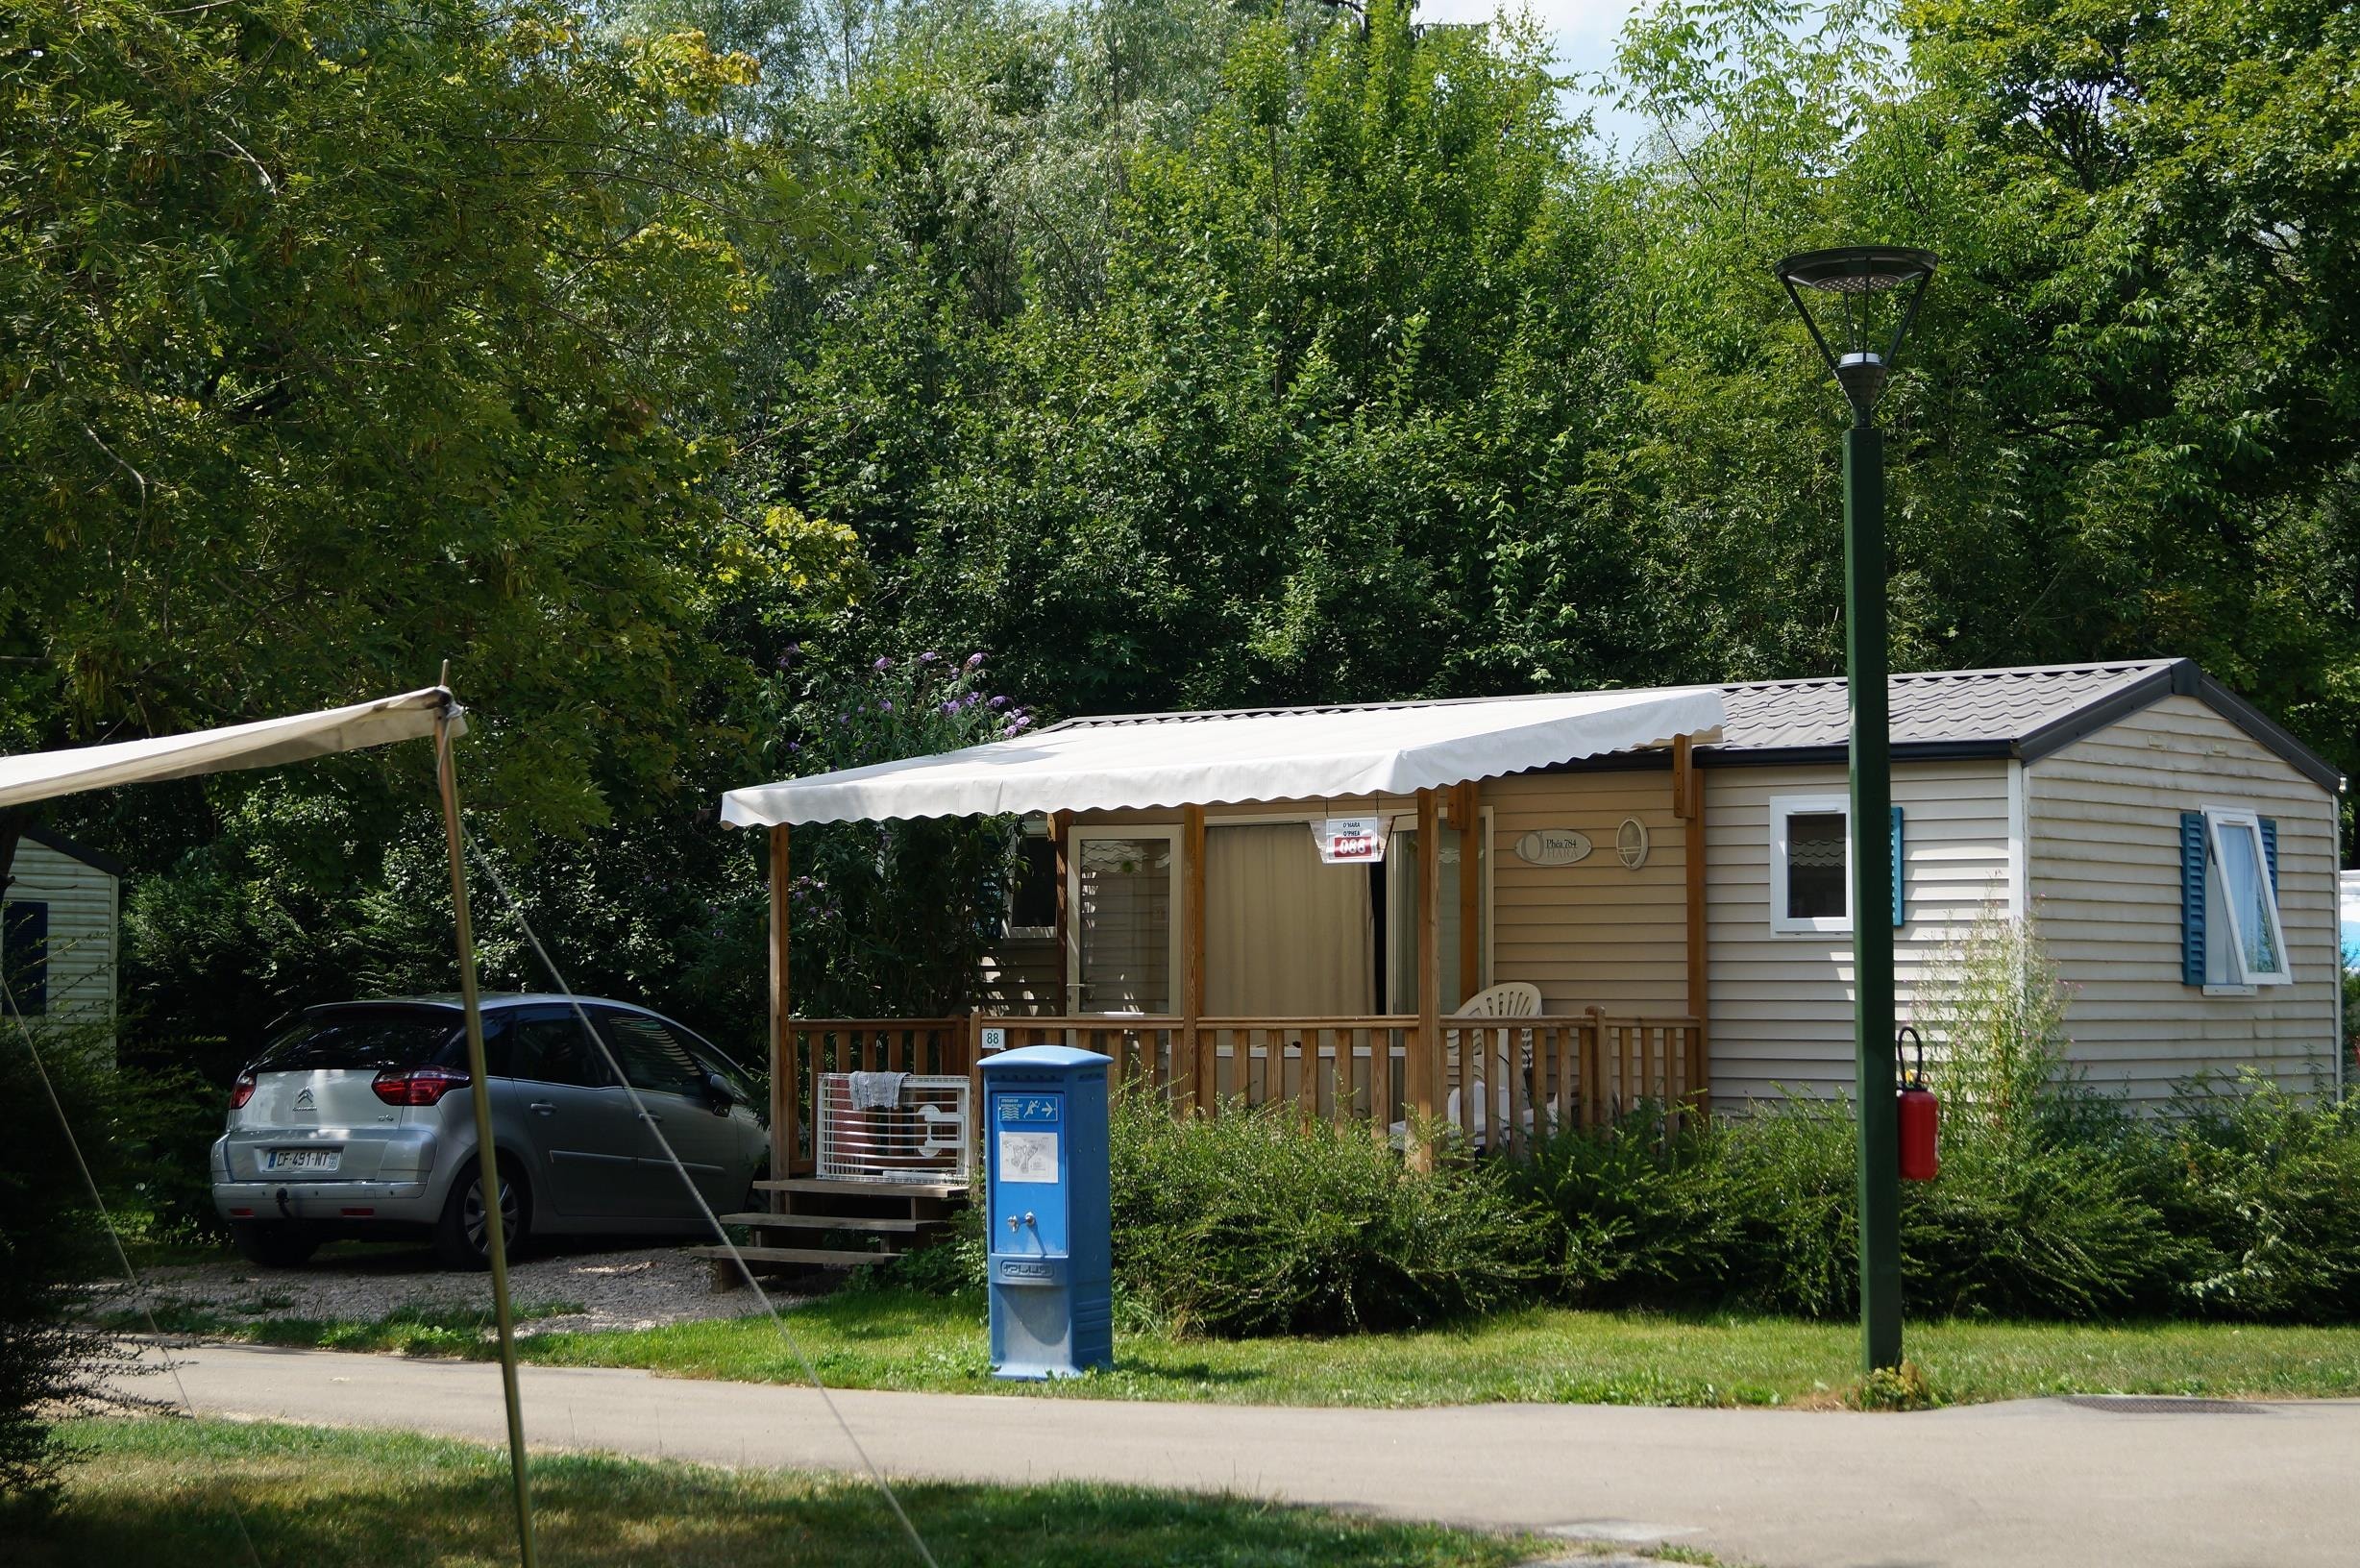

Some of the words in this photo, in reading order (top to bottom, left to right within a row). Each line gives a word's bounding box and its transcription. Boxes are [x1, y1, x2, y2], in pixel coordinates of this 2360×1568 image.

[1564, 839, 1577, 848] 784
[987, 1032, 999, 1044] 88
[276, 1152, 330, 1166] CF-491-NT
